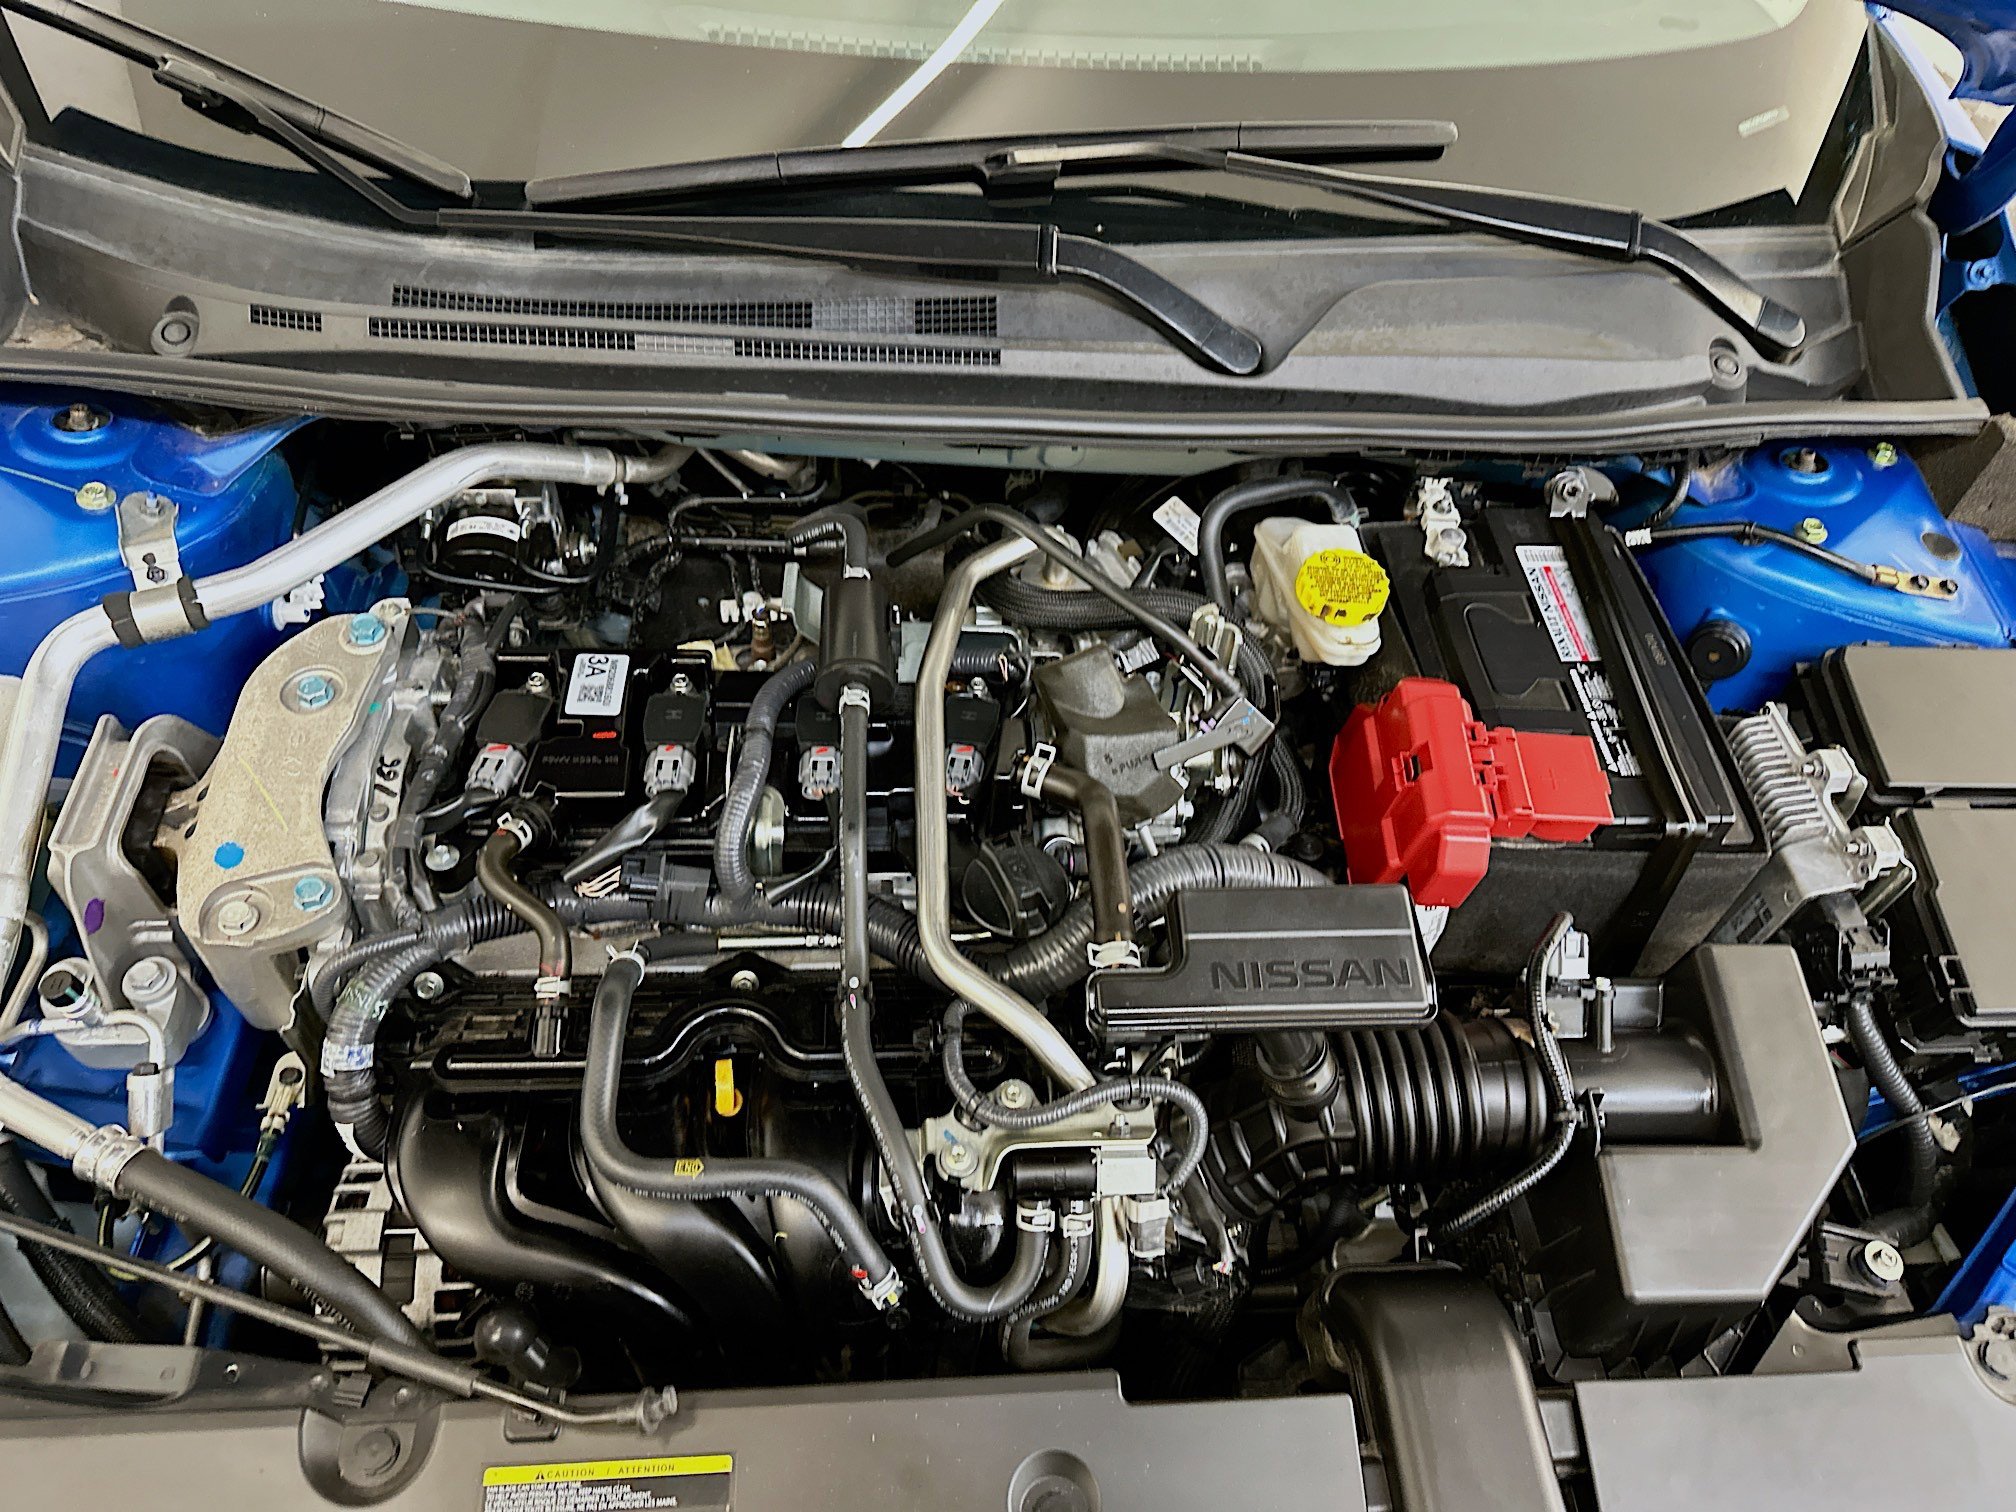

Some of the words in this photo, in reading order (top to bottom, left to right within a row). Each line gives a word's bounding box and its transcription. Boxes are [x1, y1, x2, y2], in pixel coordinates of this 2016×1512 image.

[585, 656, 609, 677] 3A
[1210, 957, 1413, 991] NISSAN
[547, 1468, 595, 1478] CAUTION
[618, 1464, 675, 1474] ATTENTION
